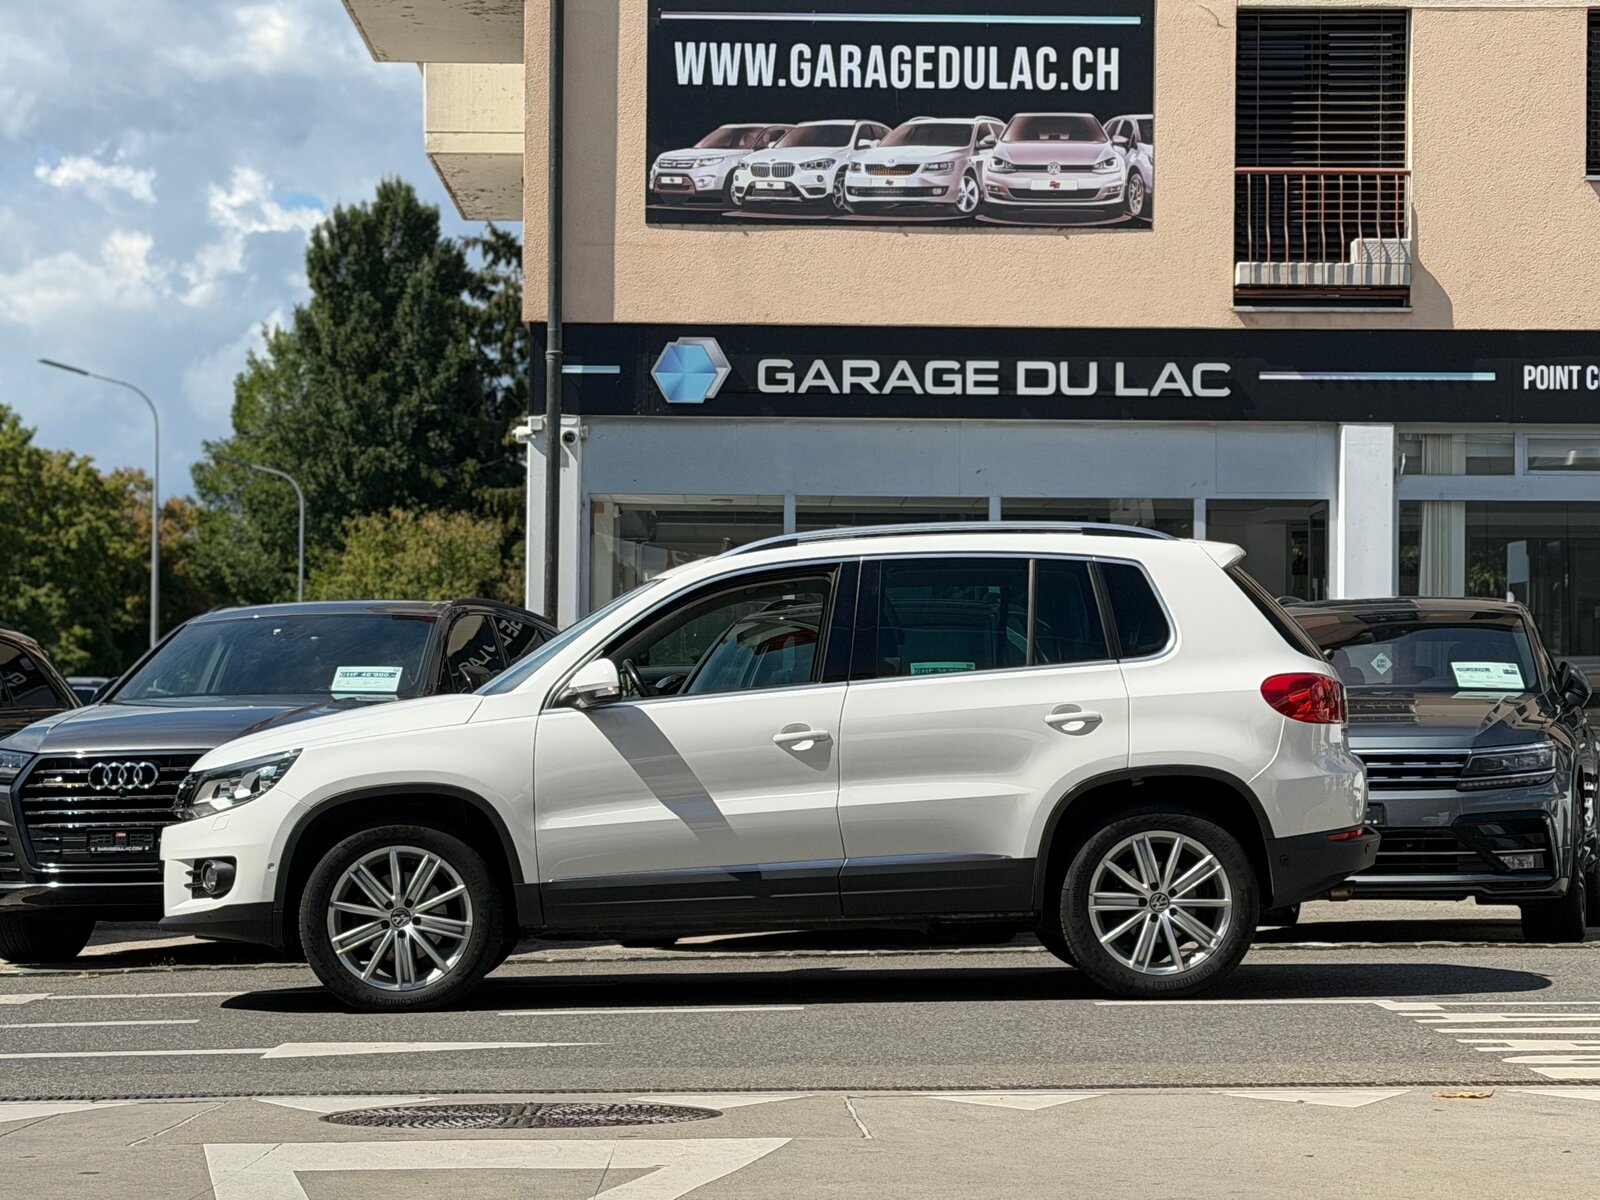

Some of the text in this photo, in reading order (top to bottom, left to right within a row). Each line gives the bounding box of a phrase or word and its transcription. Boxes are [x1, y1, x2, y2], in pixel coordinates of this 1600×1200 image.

[674, 41, 1119, 91] WWW.GARAGEDULAC.CH
[757, 358, 1231, 397] GARAGE DU LAC
[1523, 365, 1600, 390] POINT C
